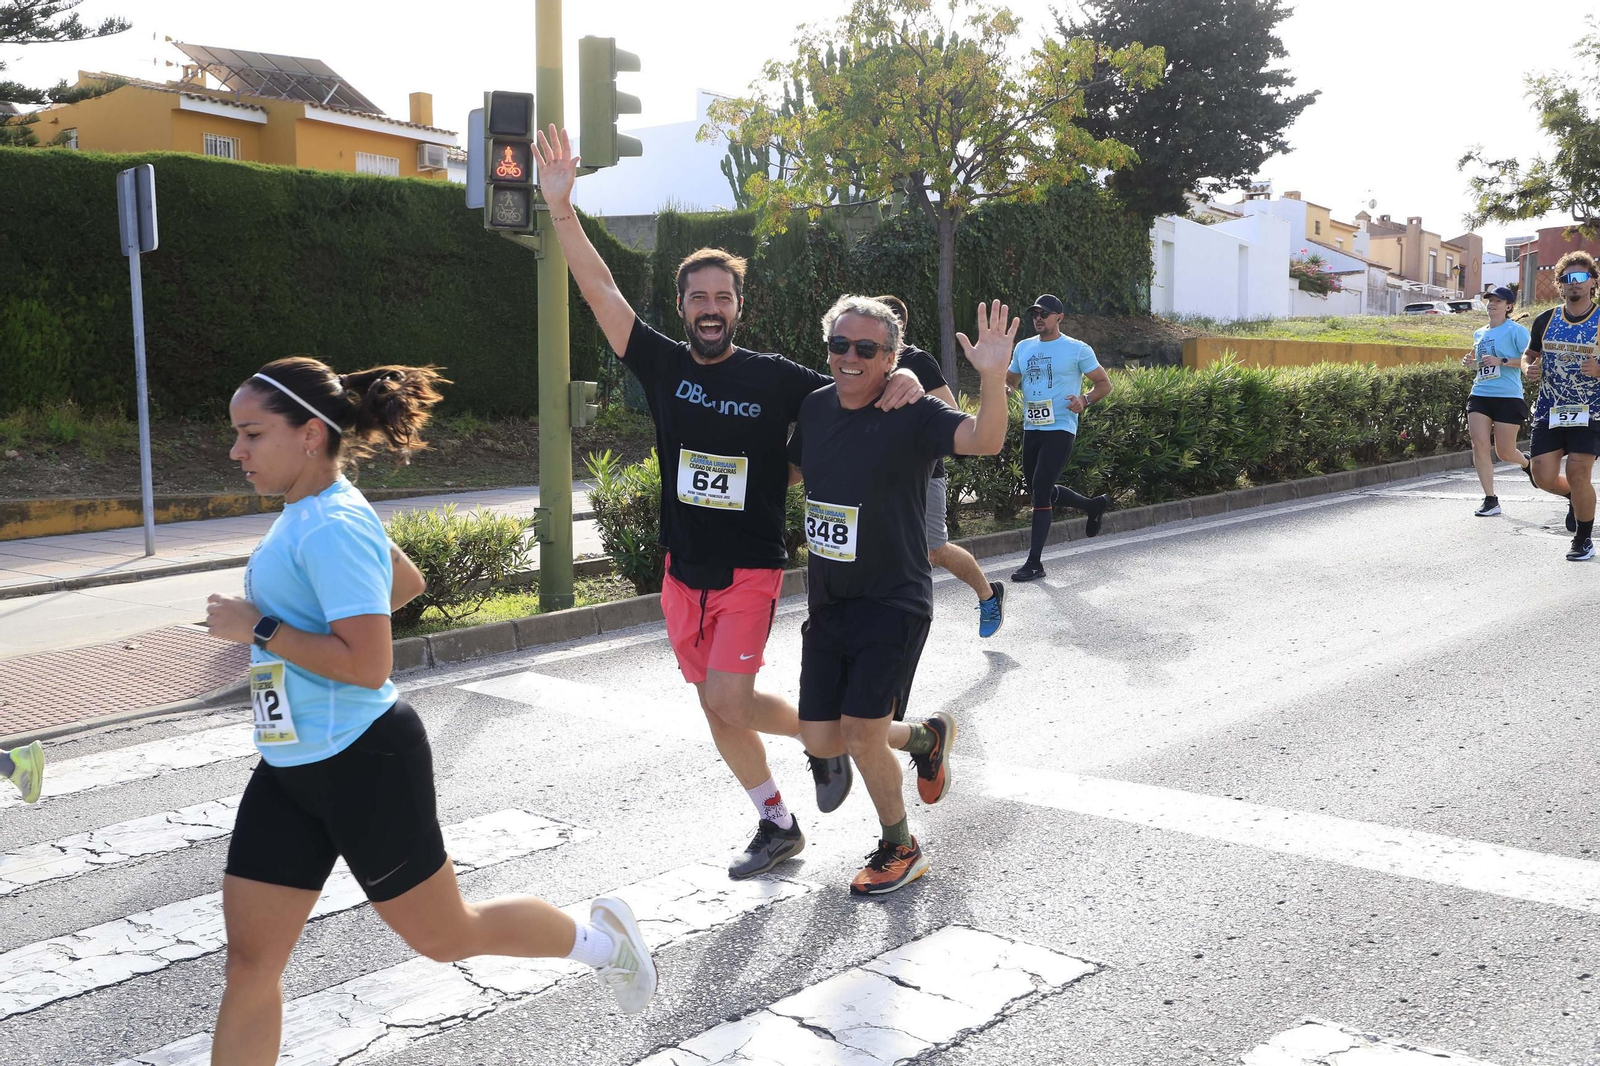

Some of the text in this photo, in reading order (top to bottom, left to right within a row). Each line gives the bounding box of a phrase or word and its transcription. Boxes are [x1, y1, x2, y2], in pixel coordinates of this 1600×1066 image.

[1479, 366, 1496, 375] 167
[1027, 408, 1050, 418] 320
[1559, 412, 1578, 420] 57
[689, 463, 705, 471] CIUDAD
[712, 467, 737, 475] ALGECIRAS
[713, 461, 737, 469] URBANA
[692, 470, 729, 494] 64
[806, 516, 848, 545] 348
